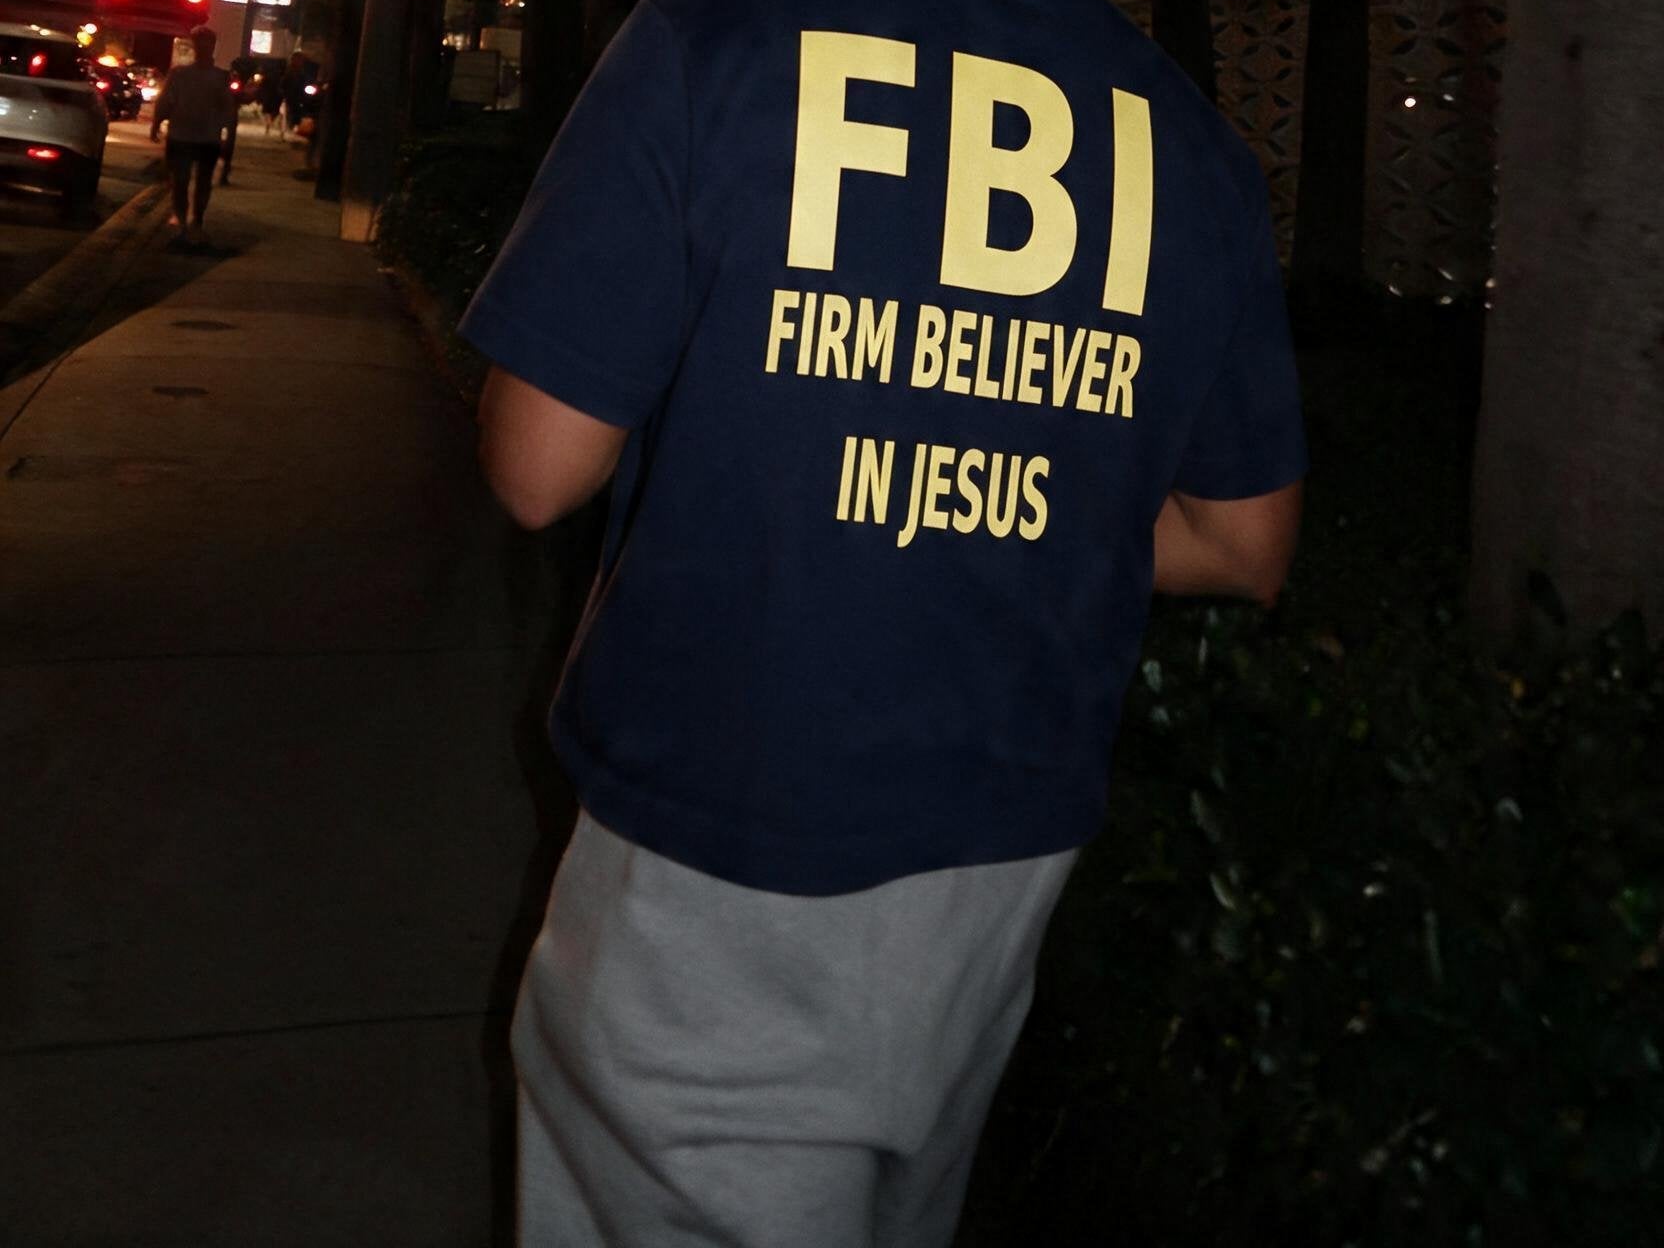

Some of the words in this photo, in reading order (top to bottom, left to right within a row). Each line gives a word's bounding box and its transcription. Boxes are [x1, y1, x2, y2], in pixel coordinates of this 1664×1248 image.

[787, 30, 1154, 317] FBI
[765, 289, 899, 384] FIRM
[910, 304, 1142, 418] BELIEVER
[836, 436, 896, 525] IN
[896, 443, 1051, 548] JESUS
